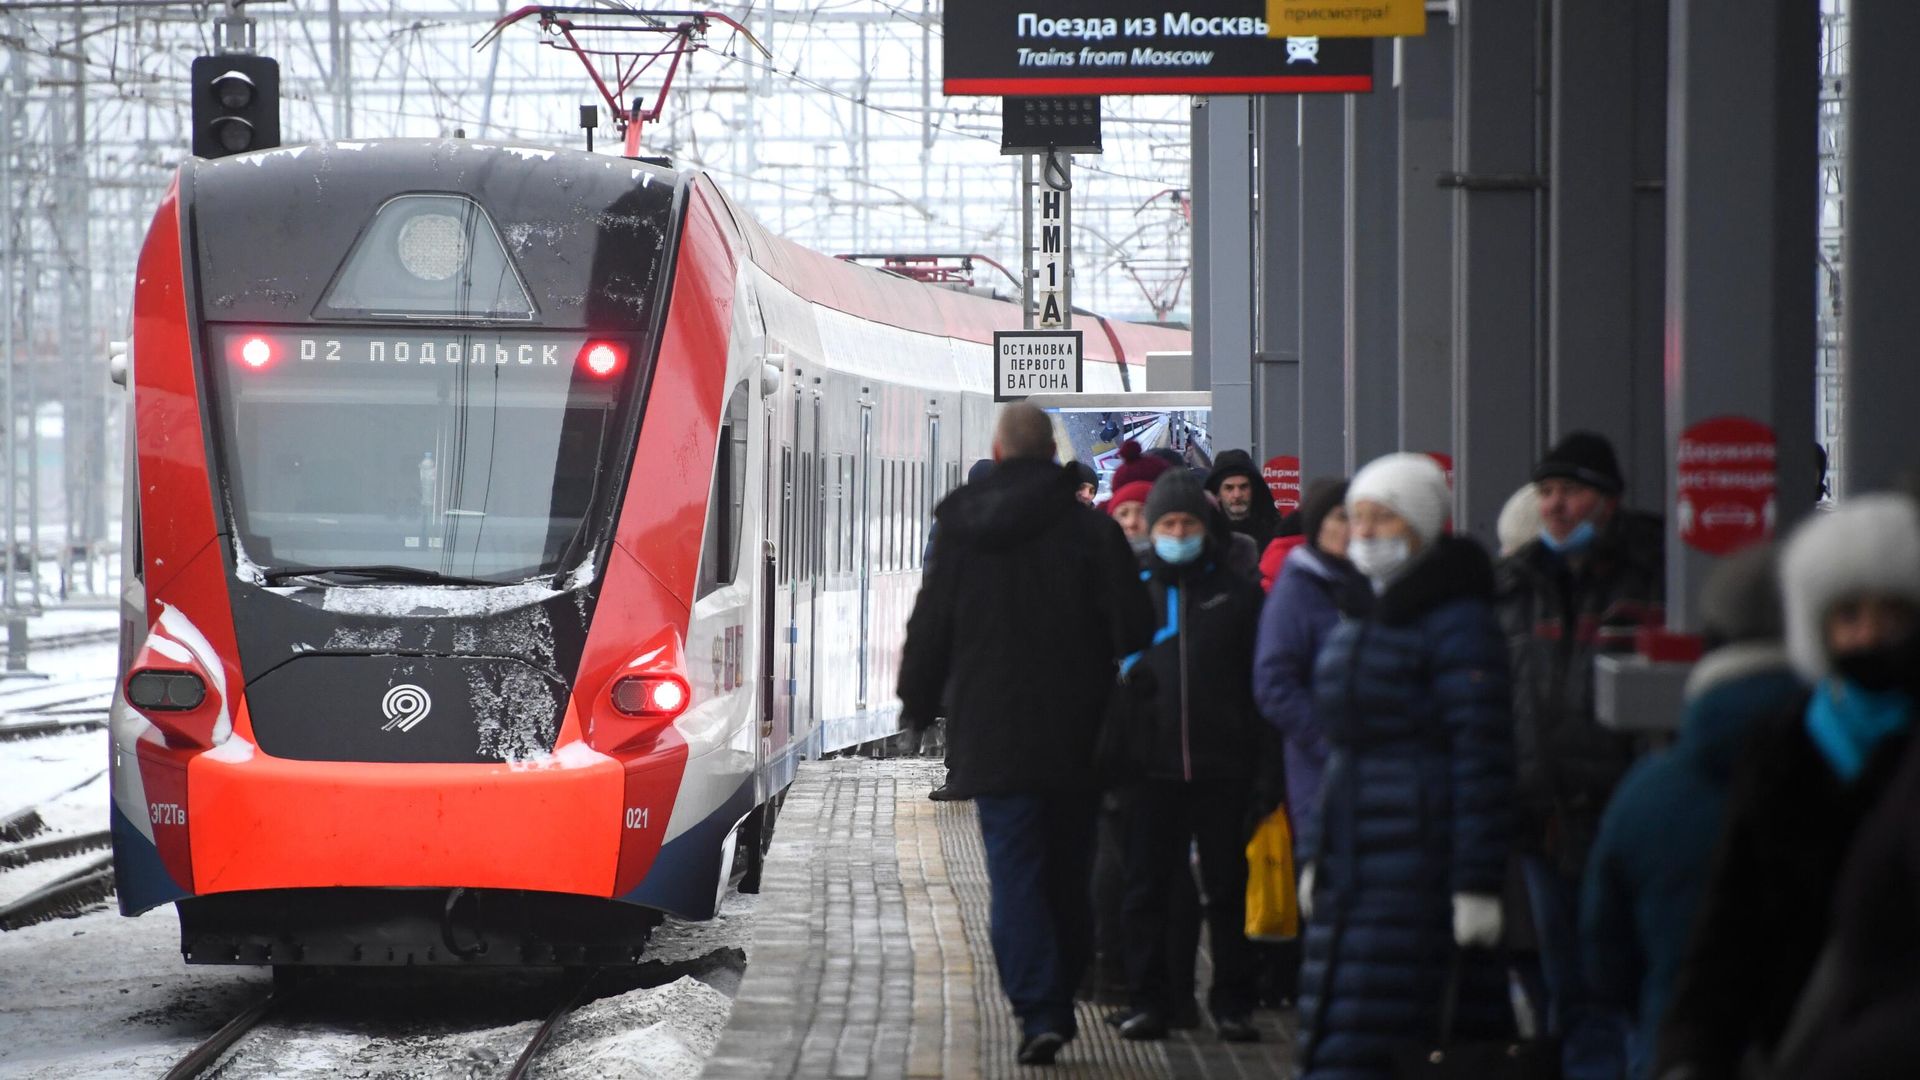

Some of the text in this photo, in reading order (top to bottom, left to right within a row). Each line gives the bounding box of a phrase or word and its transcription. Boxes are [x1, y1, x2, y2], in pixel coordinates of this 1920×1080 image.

[1284, 5, 1392, 23] присмотра!
[1018, 13, 1118, 40] Поезда
[1124, 18, 1157, 36] из
[1017, 47, 1215, 66] Trains from Moscow
[370, 341, 558, 365] ПОДОЛЬСК
[1003, 343, 1073, 356] ОСТАНОВКА
[1011, 359, 1065, 371] ПЕРВОГО
[1007, 373, 1069, 389] ВАГОНА
[1263, 466, 1299, 478] Держи
[626, 807, 648, 829] 021
